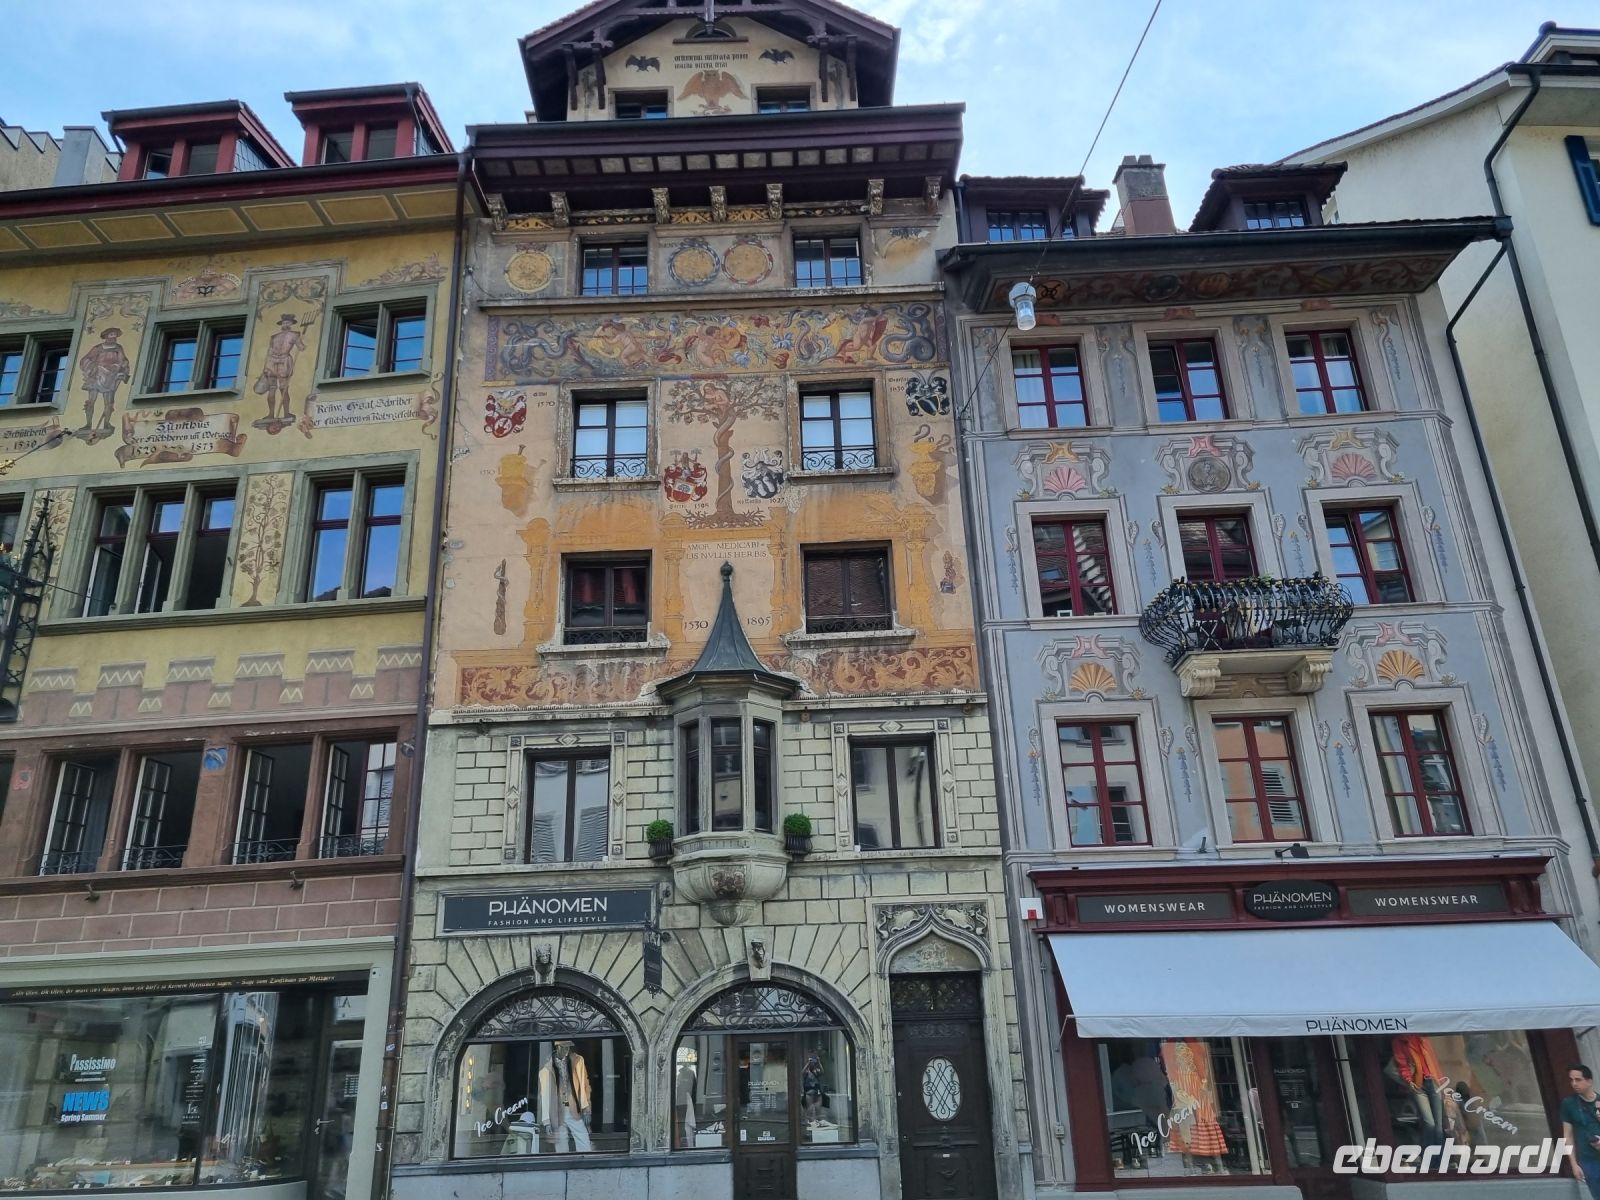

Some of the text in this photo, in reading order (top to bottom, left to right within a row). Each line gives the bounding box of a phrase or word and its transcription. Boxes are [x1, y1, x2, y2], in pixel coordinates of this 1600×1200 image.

[686, 552, 699, 560] LIS
[683, 620, 709, 631] 1530
[747, 616, 771, 626] 1895
[1253, 891, 1332, 904] PHÄNOMEN
[1374, 895, 1479, 907] WOMENSWEAR
[489, 896, 608, 916] PHÄNOMEN
[1104, 902, 1206, 914] WOMENSWEAR
[1306, 1016, 1408, 1032] PHÄNOMEN
[63, 1090, 110, 1112] NEWS
[1436, 1076, 1518, 1135] Ice Cream
[61, 1113, 106, 1122] Spring Summer
[474, 1096, 528, 1138] Ice Cream
[1131, 1100, 1200, 1155] Ice Cream
